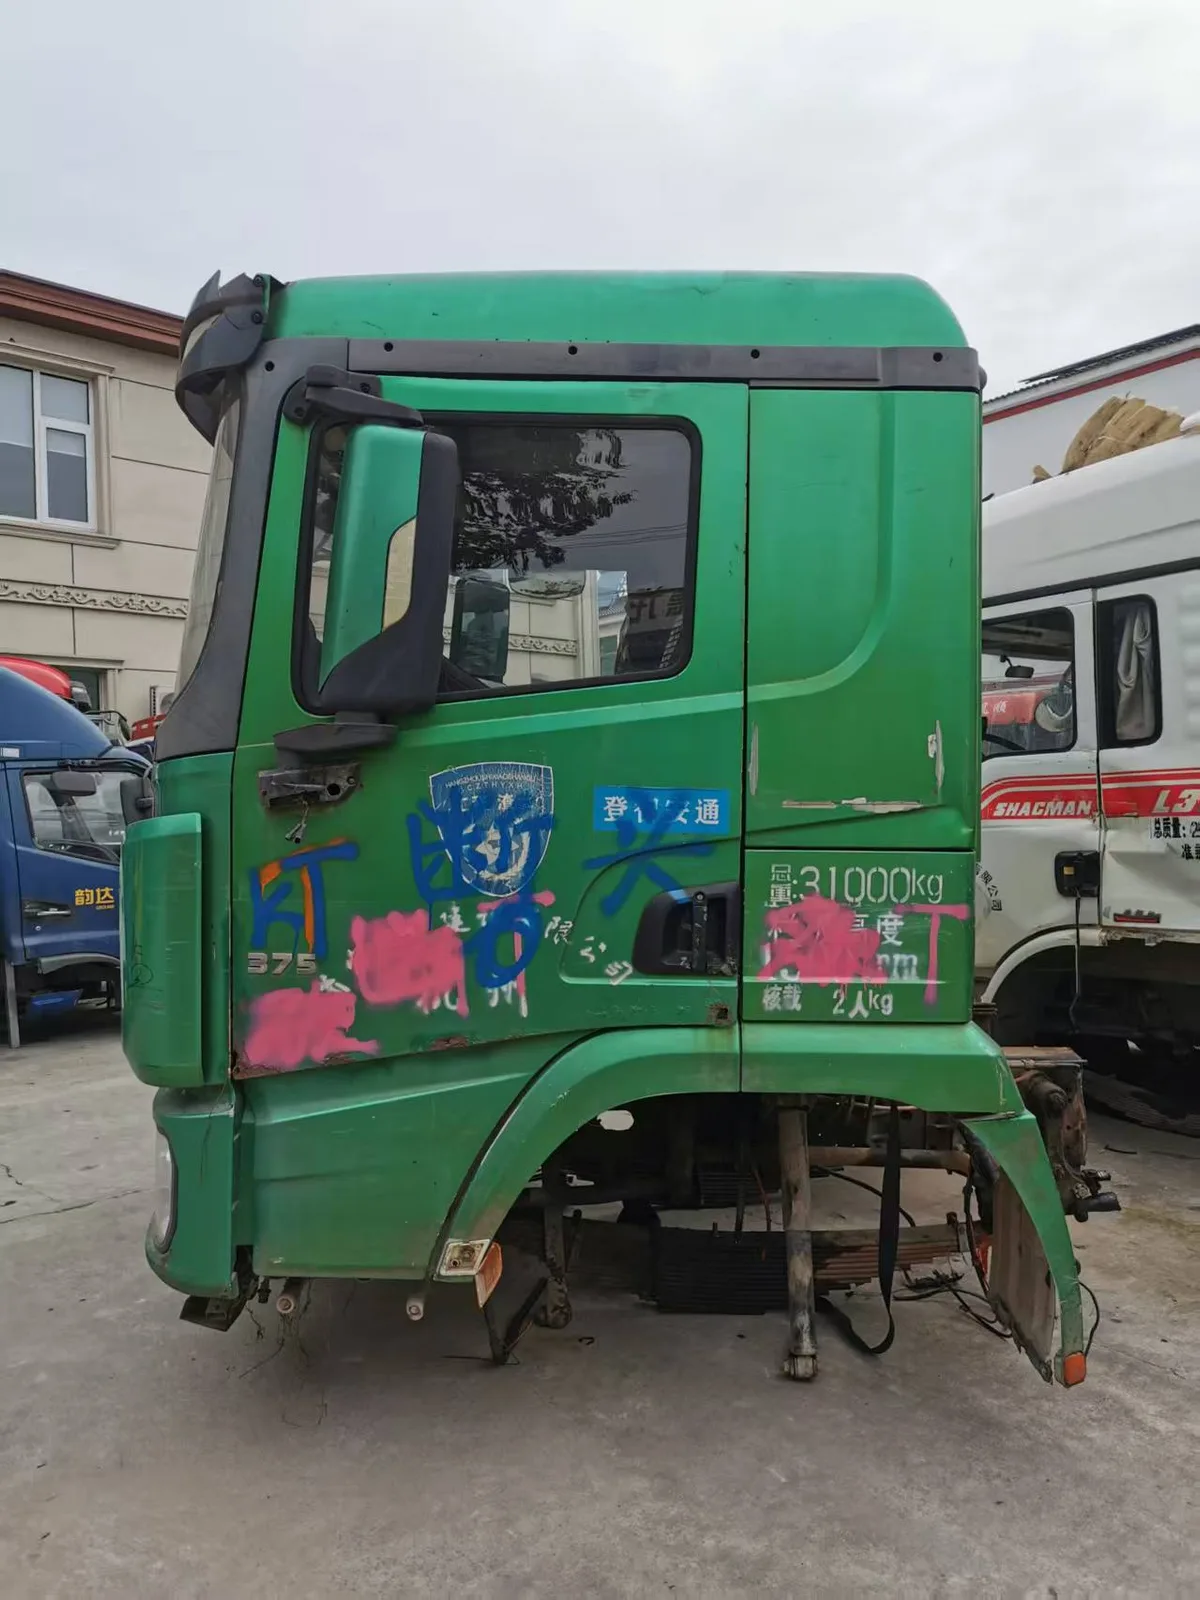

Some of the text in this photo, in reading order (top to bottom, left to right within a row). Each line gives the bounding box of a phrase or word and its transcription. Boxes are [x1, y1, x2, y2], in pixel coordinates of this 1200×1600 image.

[993, 801, 1093, 816] SHACMAN
[75, 887, 115, 906] 韵达
[247, 952, 317, 975] 375
